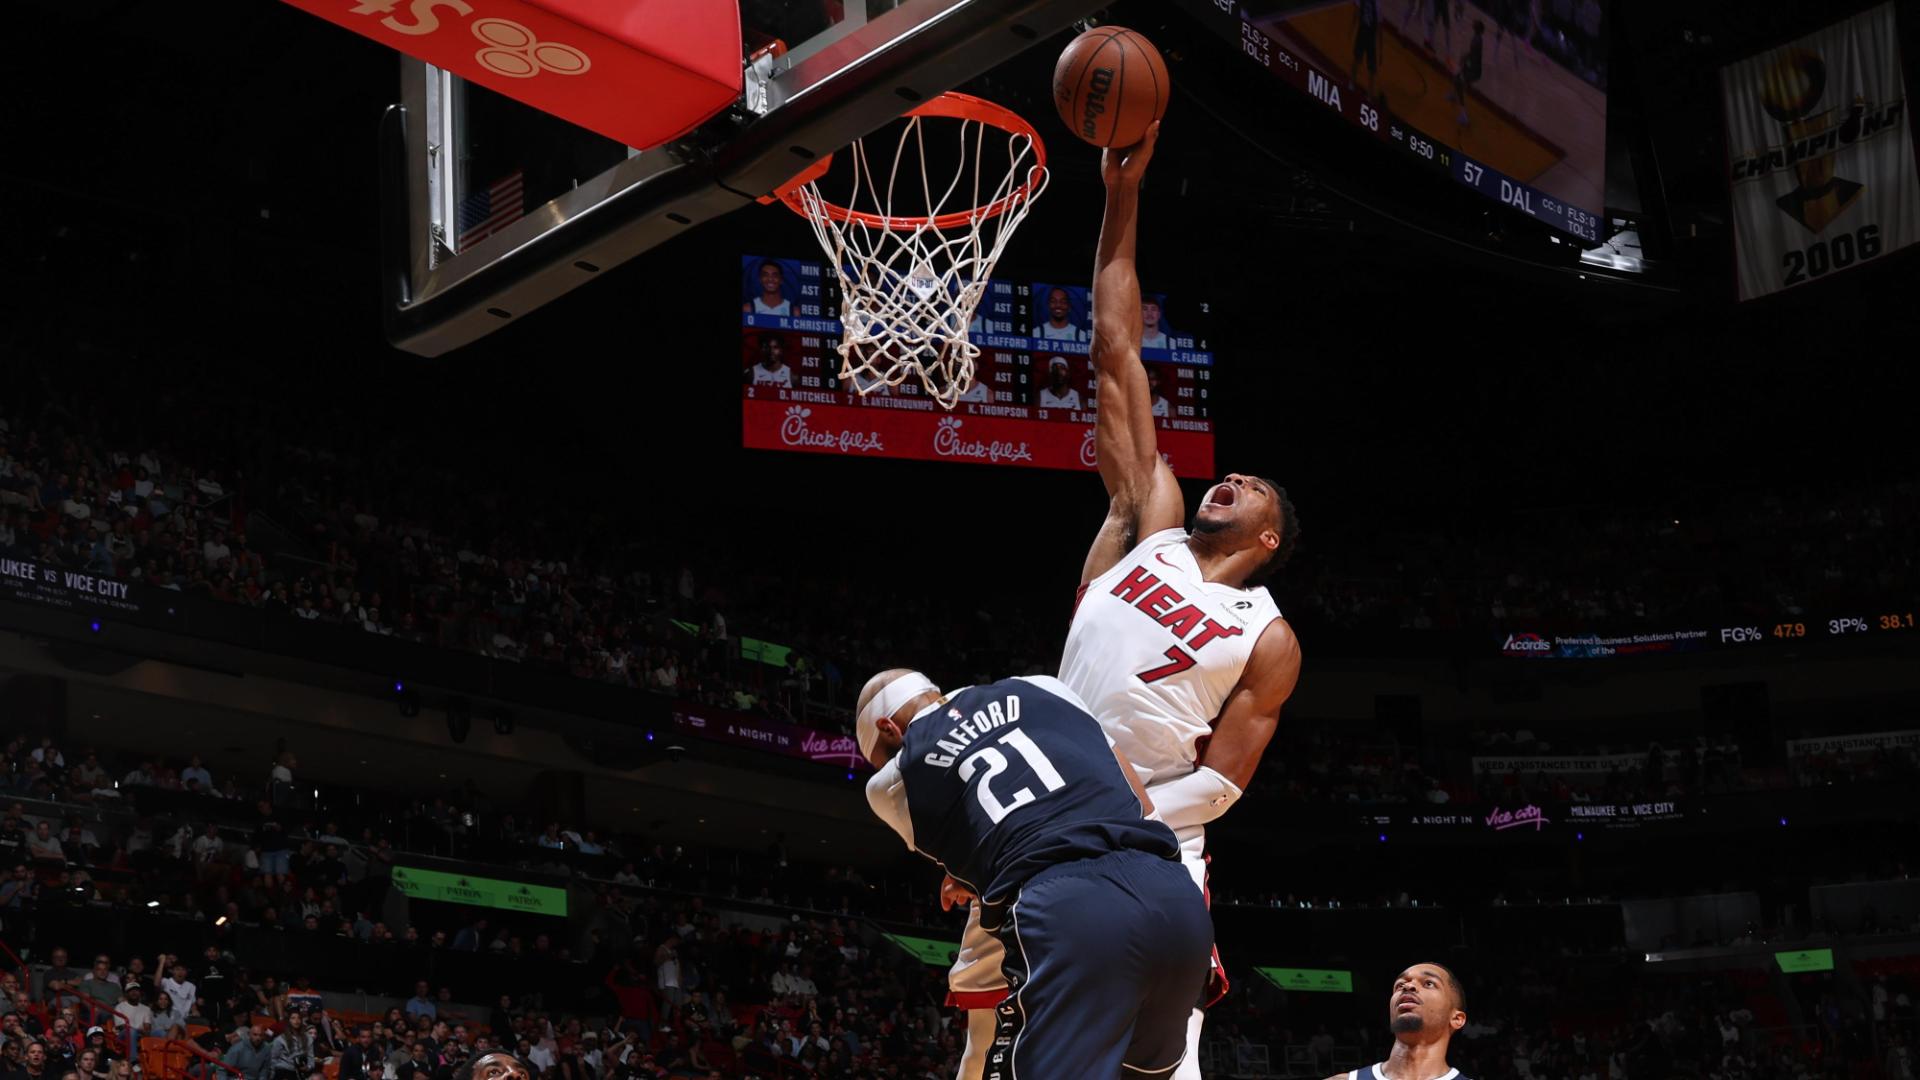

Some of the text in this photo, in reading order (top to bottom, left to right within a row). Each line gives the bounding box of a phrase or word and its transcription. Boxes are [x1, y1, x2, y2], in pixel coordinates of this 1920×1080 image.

[1308, 69, 1342, 112] MIA
[1083, 67, 1115, 139] Wilson
[1360, 103, 1379, 132] 58
[1409, 135, 1435, 160] 9:50
[1440, 153, 1450, 167] 11
[1464, 161, 1484, 187] 57
[1501, 179, 1536, 216] DAL
[1783, 224, 1881, 286] 2006
[801, 265, 820, 277] MIN
[801, 284, 835, 299] AST 1
[994, 283, 1030, 297] MIN 16
[801, 304, 836, 318] REB 2
[994, 302, 1027, 316] AST 2
[780, 317, 791, 329] M.
[793, 319, 837, 332] CHRISTIE
[994, 321, 1027, 335] REB 4
[801, 336, 820, 349] MIN
[987, 336, 1028, 349] GAFFORD
[1037, 339, 1049, 351] 25
[1052, 341, 1061, 352] P.
[1176, 337, 1207, 350] REB 4
[801, 356, 835, 370] AST 1
[994, 353, 1030, 366] MIN 10
[1171, 352, 1209, 365] C. FLAGG
[994, 371, 1027, 385] AST 0
[1177, 368, 1195, 379] MIN
[801, 376, 836, 389] REB 0
[900, 383, 918, 395] REB
[747, 386, 755, 399] 2
[791, 390, 837, 404] MITCHELL
[994, 390, 1027, 403] REB 1
[1177, 387, 1208, 399] AST 0
[847, 395, 854, 406] 7
[968, 404, 1028, 419] K. THOMPSON
[1038, 409, 1049, 420] 13
[1070, 411, 1080, 423] B.
[1177, 405, 1208, 418] REB 1
[781, 408, 884, 451] Chick-fil-A
[1161, 418, 1209, 432] A. WIGGINS
[934, 419, 1033, 463] Chick-fil-A
[0, 557, 36, 580] UKEE
[64, 571, 95, 593] VICE
[97, 578, 129, 600] CITY
[1110, 565, 1244, 652] HEAT
[1828, 612, 1915, 635] 3P% 38.1
[1720, 622, 1806, 643] FG% 47.9
[1503, 634, 1551, 651] Acordis
[1555, 635, 1594, 646] Preferred
[1633, 633, 1674, 643] Solutions
[1675, 630, 1708, 640] Partner
[1136, 644, 1198, 684] 7
[924, 695, 1020, 767] GAFFORD
[727, 725, 736, 735] A
[739, 727, 774, 743] NIGHT
[777, 735, 790, 746] IN
[802, 731, 828, 753] Vice
[958, 727, 1066, 825] 21
[1411, 816, 1420, 825] A
[1423, 816, 1456, 825] NIGHT
[1460, 816, 1473, 825] IN
[1570, 805, 1617, 816] MILWAUKEE
[1632, 803, 1652, 815] VICE
[1654, 802, 1675, 814] CITY
